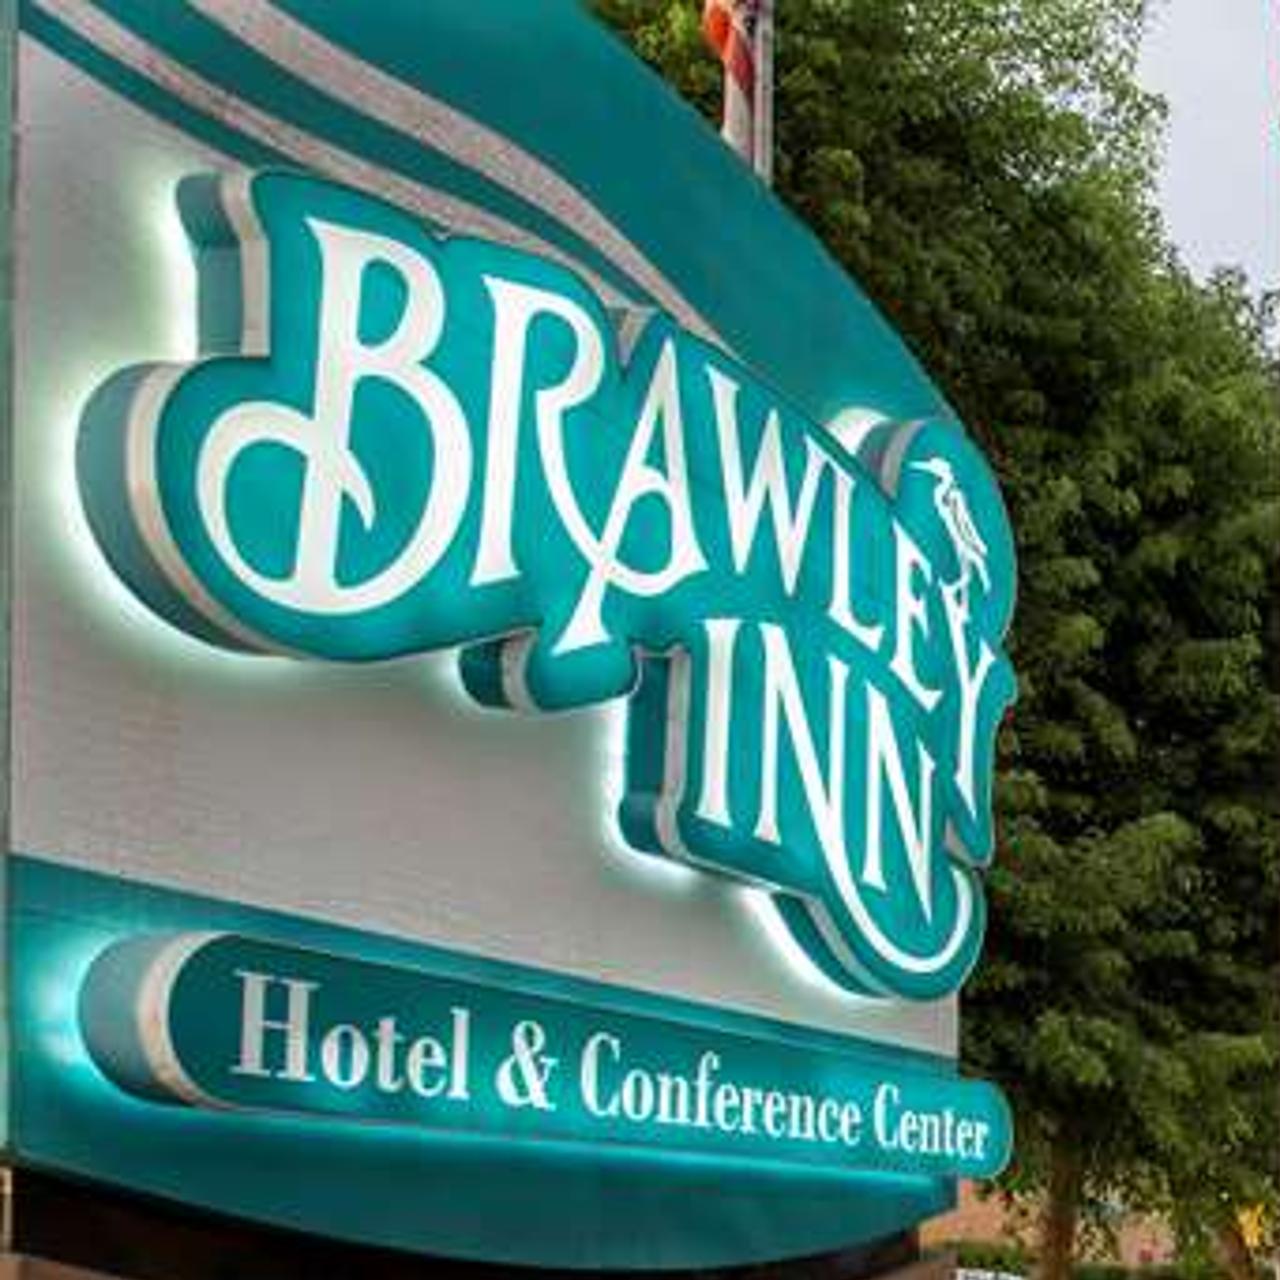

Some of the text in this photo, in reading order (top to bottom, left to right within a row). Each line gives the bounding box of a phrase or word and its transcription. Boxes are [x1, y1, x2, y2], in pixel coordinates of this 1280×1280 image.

[197, 216, 995, 818] BRAWLEY
[695, 618, 971, 974] INN
[229, 968, 990, 1161] Hotel & Conference Center
